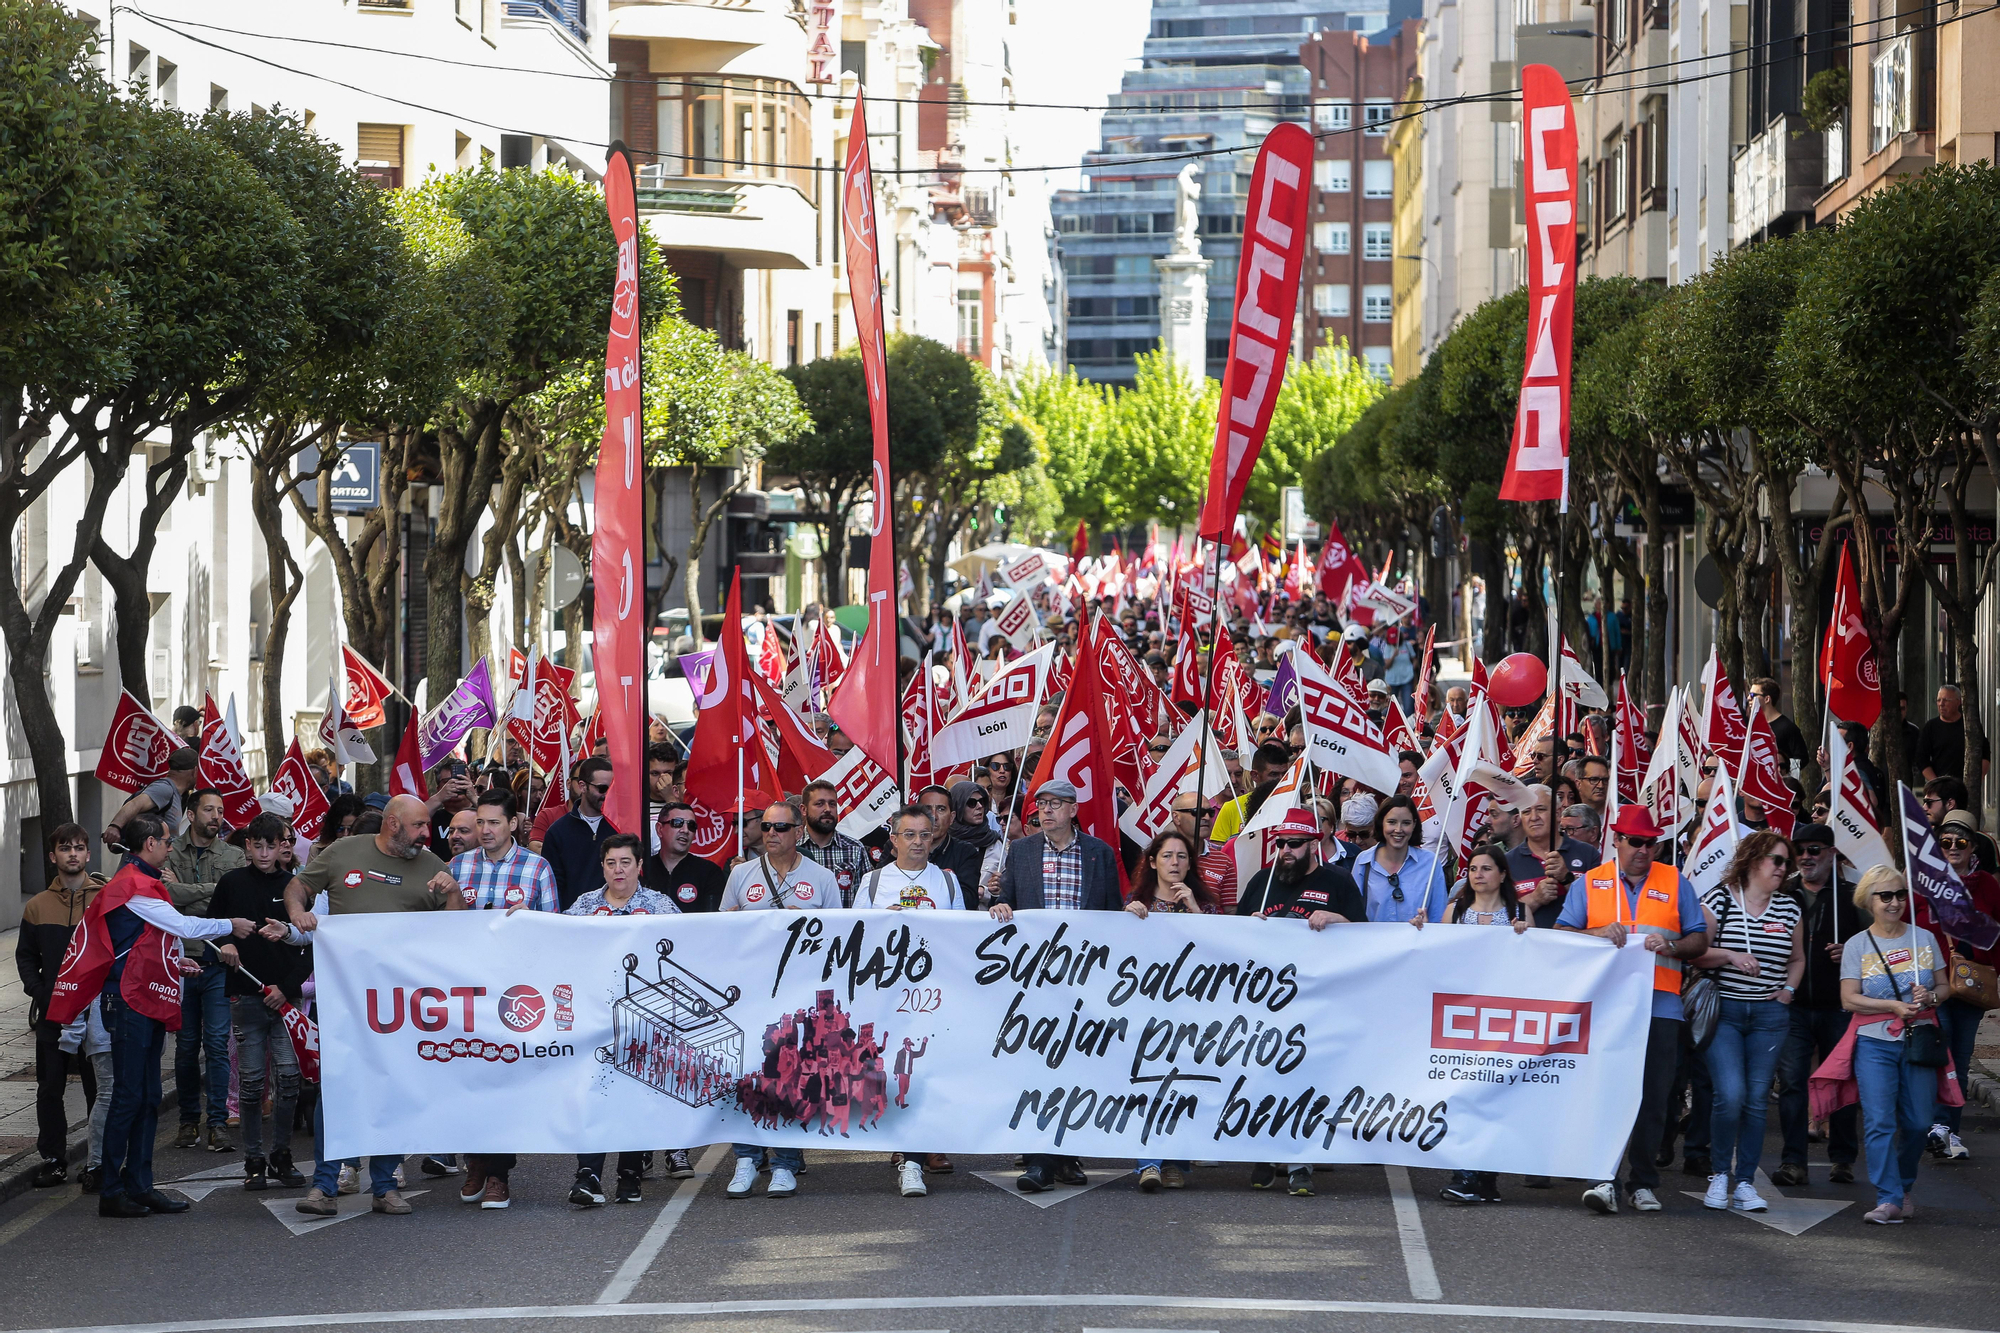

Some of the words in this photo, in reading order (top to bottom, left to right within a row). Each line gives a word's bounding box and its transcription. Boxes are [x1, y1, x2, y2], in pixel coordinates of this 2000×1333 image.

[330, 487, 369, 497] ORTIZO
[977, 719, 1008, 737] León
[1313, 733, 1347, 757] León
[869, 783, 900, 812] León
[1836, 810, 1866, 840] León
[1693, 849, 1726, 878] León
[749, 886, 763, 896] UGT
[796, 883, 812, 894] UGT
[1304, 891, 1328, 900] CCOO
[1918, 871, 1963, 902] mujer
[975, 921, 1110, 989] Subir
[1108, 941, 1299, 1013] salarios
[149, 981, 178, 997] mano
[896, 988, 942, 1015] 2023
[366, 987, 487, 1034] UGT
[991, 992, 1129, 1070] bajar
[1130, 1017, 1307, 1084] precios
[1442, 1004, 1582, 1047] CCOO
[522, 1040, 575, 1059] León
[1429, 1053, 1514, 1070] comisiones
[1518, 1055, 1577, 1072] obreras
[1427, 1068, 1446, 1083] de
[1450, 1069, 1505, 1085] Castilla
[1508, 1074, 1518, 1086] y
[1521, 1068, 1561, 1085] León
[1009, 1069, 1197, 1148] repartir
[1213, 1075, 1448, 1152] beneficios
